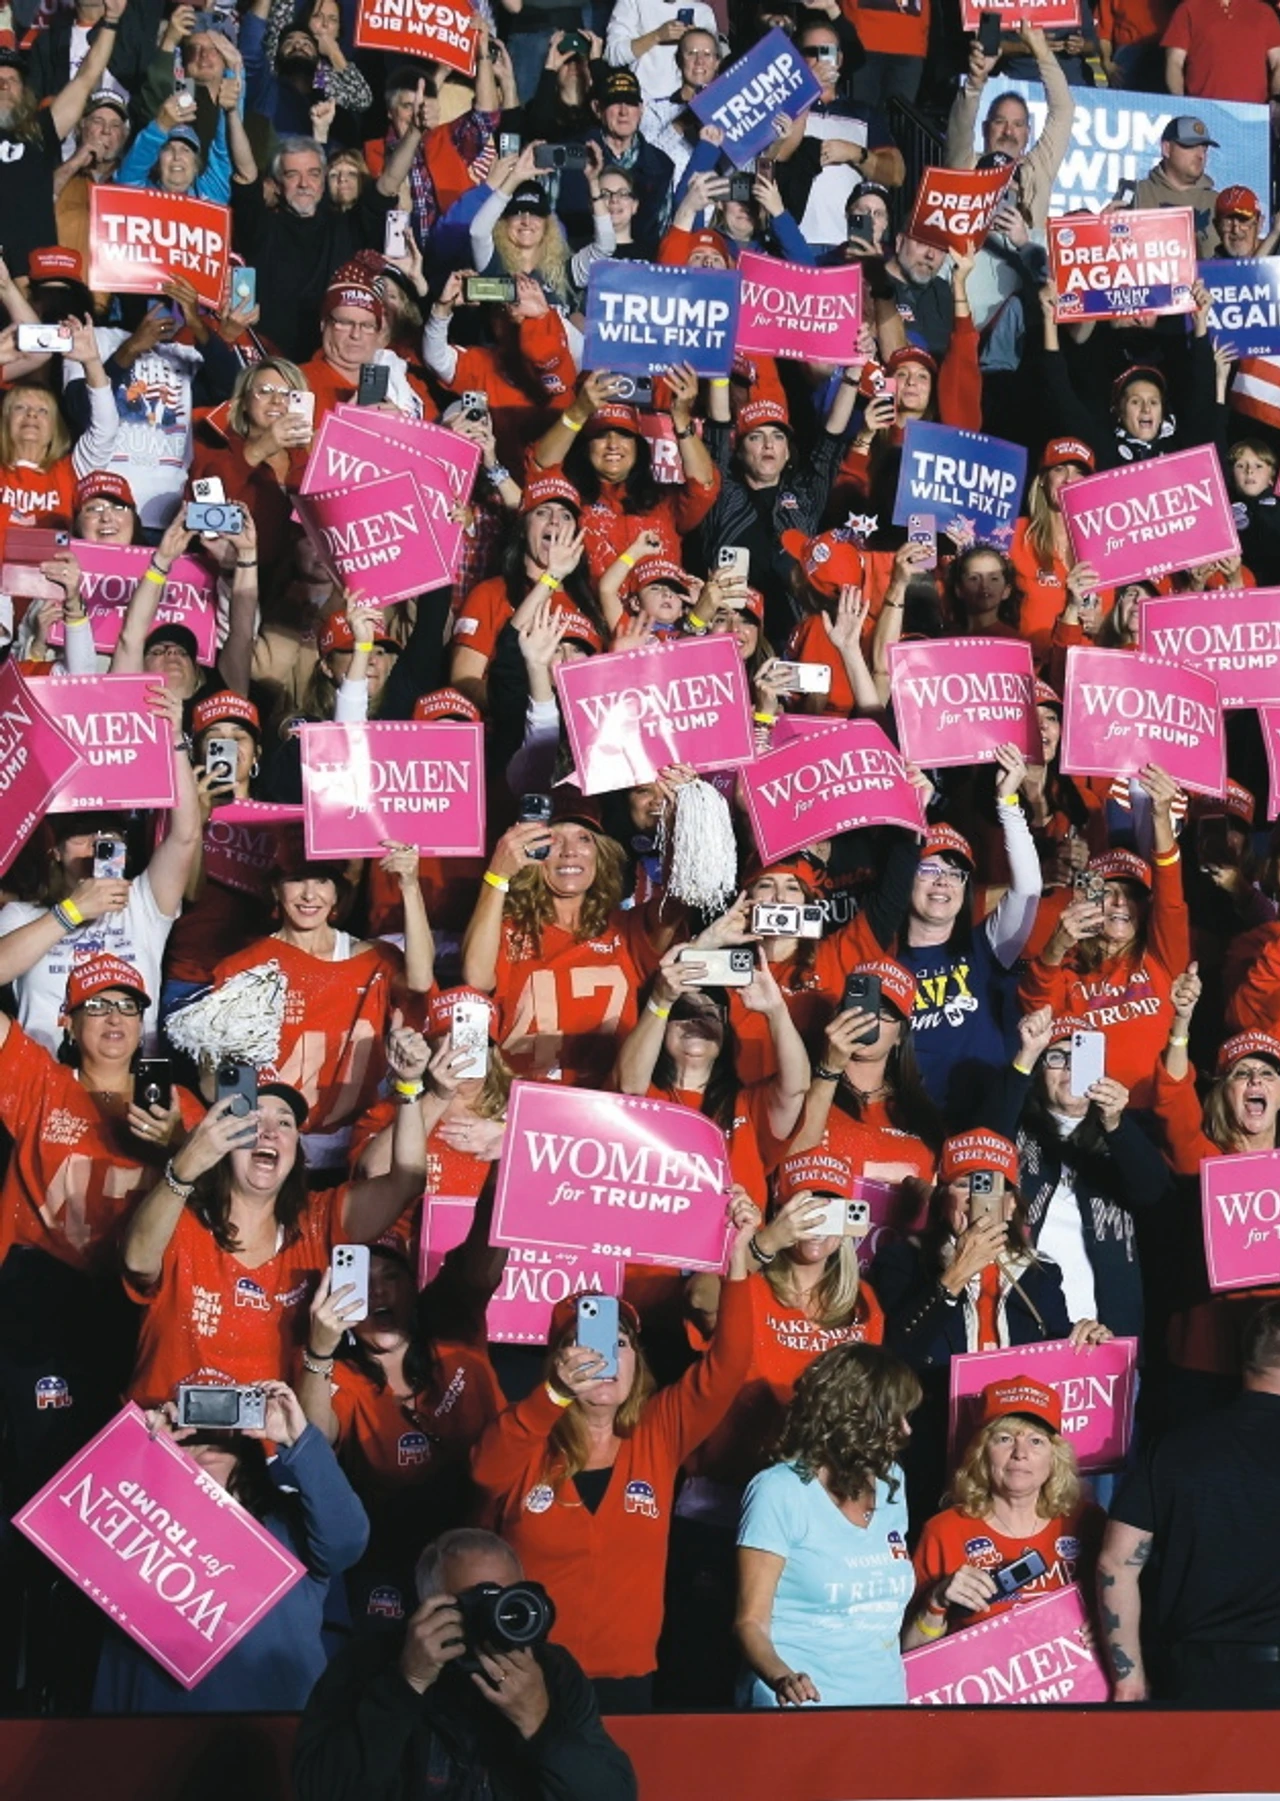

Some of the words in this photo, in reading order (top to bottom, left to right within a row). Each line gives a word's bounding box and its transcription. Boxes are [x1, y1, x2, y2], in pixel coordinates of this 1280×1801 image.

[409, 18, 470, 52] DREAM
[711, 53, 794, 127] TRUMP
[725, 104, 766, 142] WILL
[764, 83, 792, 112] FIX
[788, 69, 804, 91] IT
[1029, 102, 1172, 150] TRUM
[102, 214, 223, 253] TRUMP
[105, 244, 162, 264] WILL
[169, 249, 201, 271] FIX
[204, 260, 221, 280] IT
[1060, 244, 1139, 264] DREAM
[1146, 240, 1187, 260] BIG,
[1067, 262, 1180, 290] AGAIN!
[740, 278, 857, 320] WOMEN
[1209, 284, 1270, 303] REAM
[600, 293, 729, 328] TRUMP
[751, 313, 771, 327] for
[776, 317, 838, 333] TRUMP
[600, 323, 656, 345] WILL
[664, 326, 699, 346] FIX
[705, 331, 725, 348] IT
[911, 450, 1018, 498] TRUMP
[911, 480, 963, 506] WILL
[968, 490, 994, 515] FIX
[996, 498, 1012, 520] IT
[1072, 478, 1214, 540] WOMEN
[1105, 535, 1126, 556] for
[1128, 516, 1197, 545] TRUMP
[89, 606, 112, 618] for
[1202, 654, 1278, 671] TRUMP
[906, 671, 1031, 707] WOMEN
[938, 709, 962, 727] for
[964, 706, 1023, 722] TRUMP
[1081, 682, 1215, 737] WOMEN
[644, 711, 719, 738] TRUMP
[1108, 720, 1132, 740] for
[1134, 722, 1199, 748] TRUMP
[89, 750, 138, 766] UMP
[758, 750, 908, 810] WOMEN
[71, 796, 104, 806] 2024
[379, 796, 450, 813] TRUMP
[793, 795, 815, 815] for
[819, 777, 895, 802] TRUMP
[836, 817, 868, 831] 2024
[914, 964, 973, 1010] AVY
[1085, 997, 1160, 1026] TRUMP
[949, 1138, 974, 1152] MAKE
[976, 1136, 1014, 1155] AMERICA
[953, 1149, 981, 1164] GREAT
[983, 1149, 1010, 1167] AGAIN
[523, 1130, 726, 1195] WOMEN
[785, 1157, 809, 1173] MAKE
[811, 1156, 851, 1176] AMERICA
[790, 1169, 819, 1184] GREAT
[821, 1172, 847, 1186] AGAIN
[549, 1184, 584, 1205] for
[589, 1186, 690, 1214] TRUMP
[592, 1242, 633, 1257] 2024
[1245, 1227, 1270, 1249] for
[192, 1472, 232, 1508] 2024
[118, 1480, 201, 1554] TRUMP
[59, 1472, 227, 1642] WOMEN
[199, 1553, 235, 1578] for
[824, 1577, 906, 1604] TRUM
